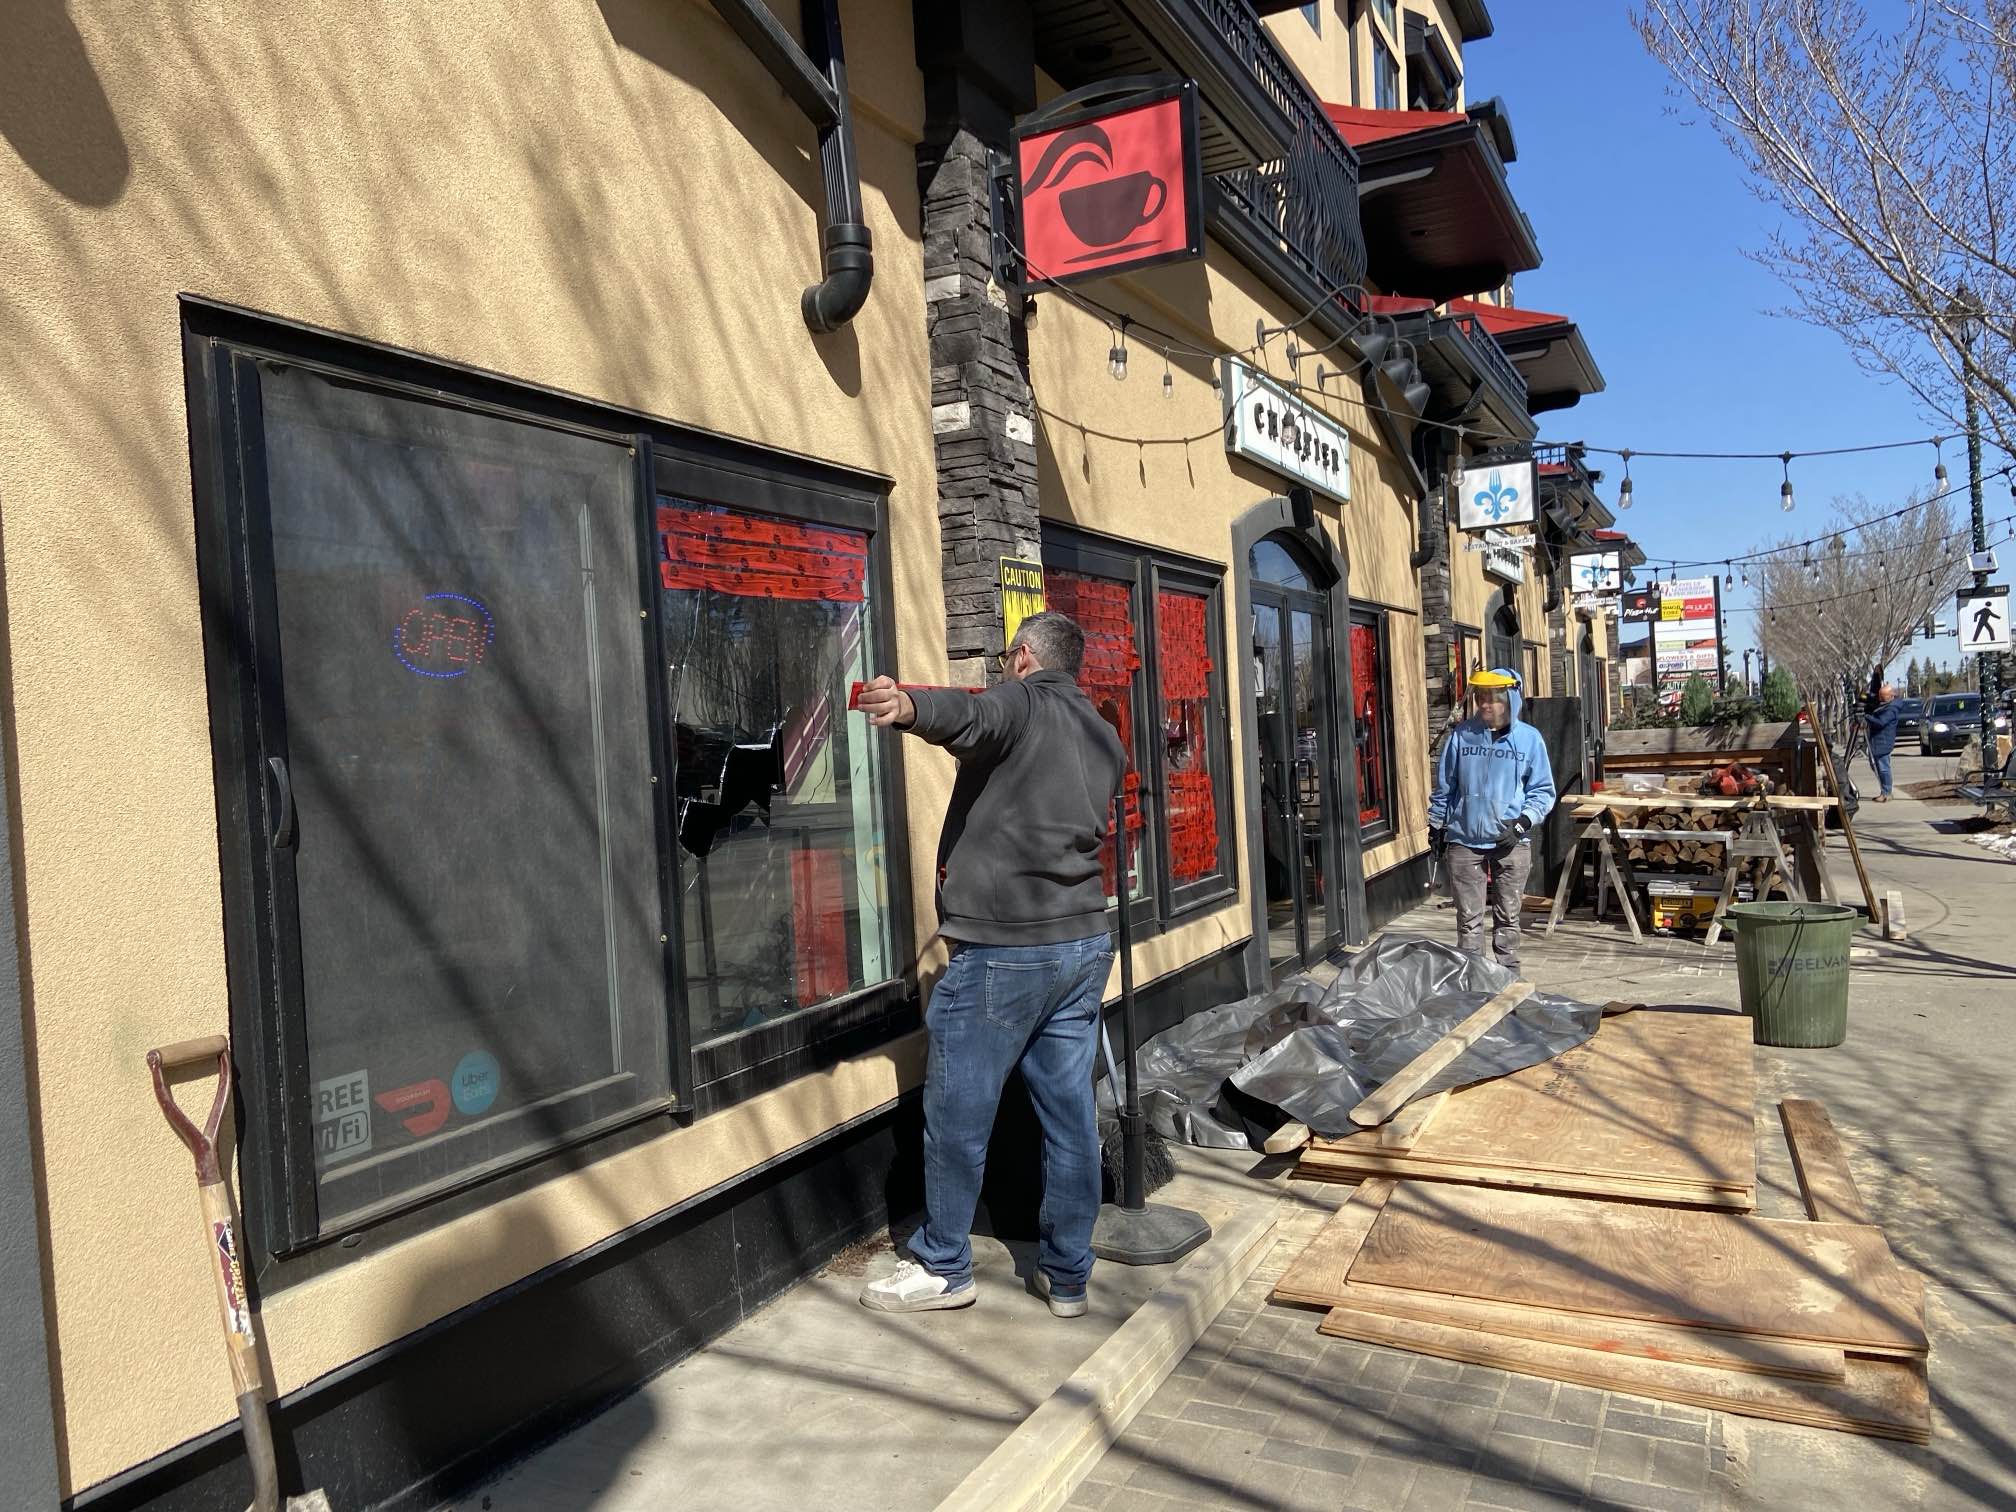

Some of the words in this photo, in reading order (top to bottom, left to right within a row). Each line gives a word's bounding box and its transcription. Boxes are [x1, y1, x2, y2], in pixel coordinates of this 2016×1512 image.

[1004, 566, 1041, 590] CAUTION
[401, 608, 488, 664] OPEN
[1462, 746, 1515, 761] BURTON
[462, 1070, 489, 1088] Uber
[319, 1079, 364, 1115] REE
